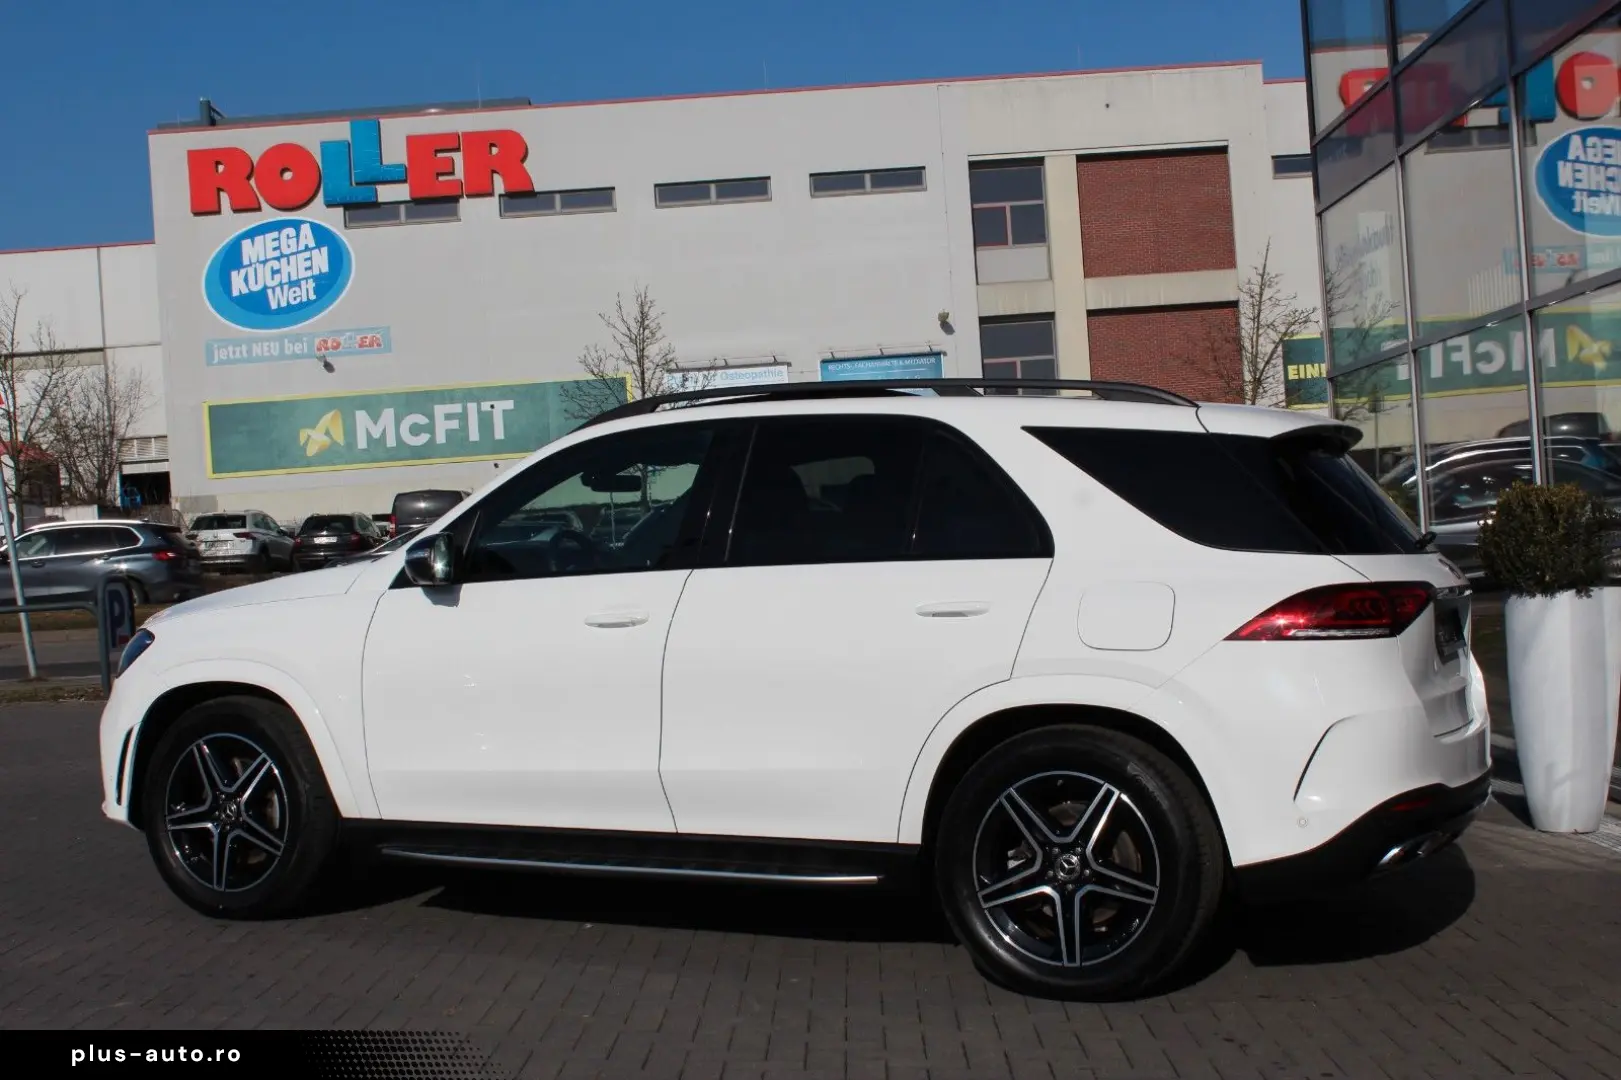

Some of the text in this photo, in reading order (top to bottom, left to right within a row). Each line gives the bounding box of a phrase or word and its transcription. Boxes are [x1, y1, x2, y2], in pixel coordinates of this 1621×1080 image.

[187, 119, 535, 216] ROLLER
[241, 223, 316, 266] MEGA
[230, 246, 329, 297] KÜCHEN
[267, 279, 316, 310] Welt
[212, 344, 248, 363] jetzt
[252, 341, 279, 357] NEU
[284, 337, 308, 355] bei
[355, 400, 515, 450] McFIT
